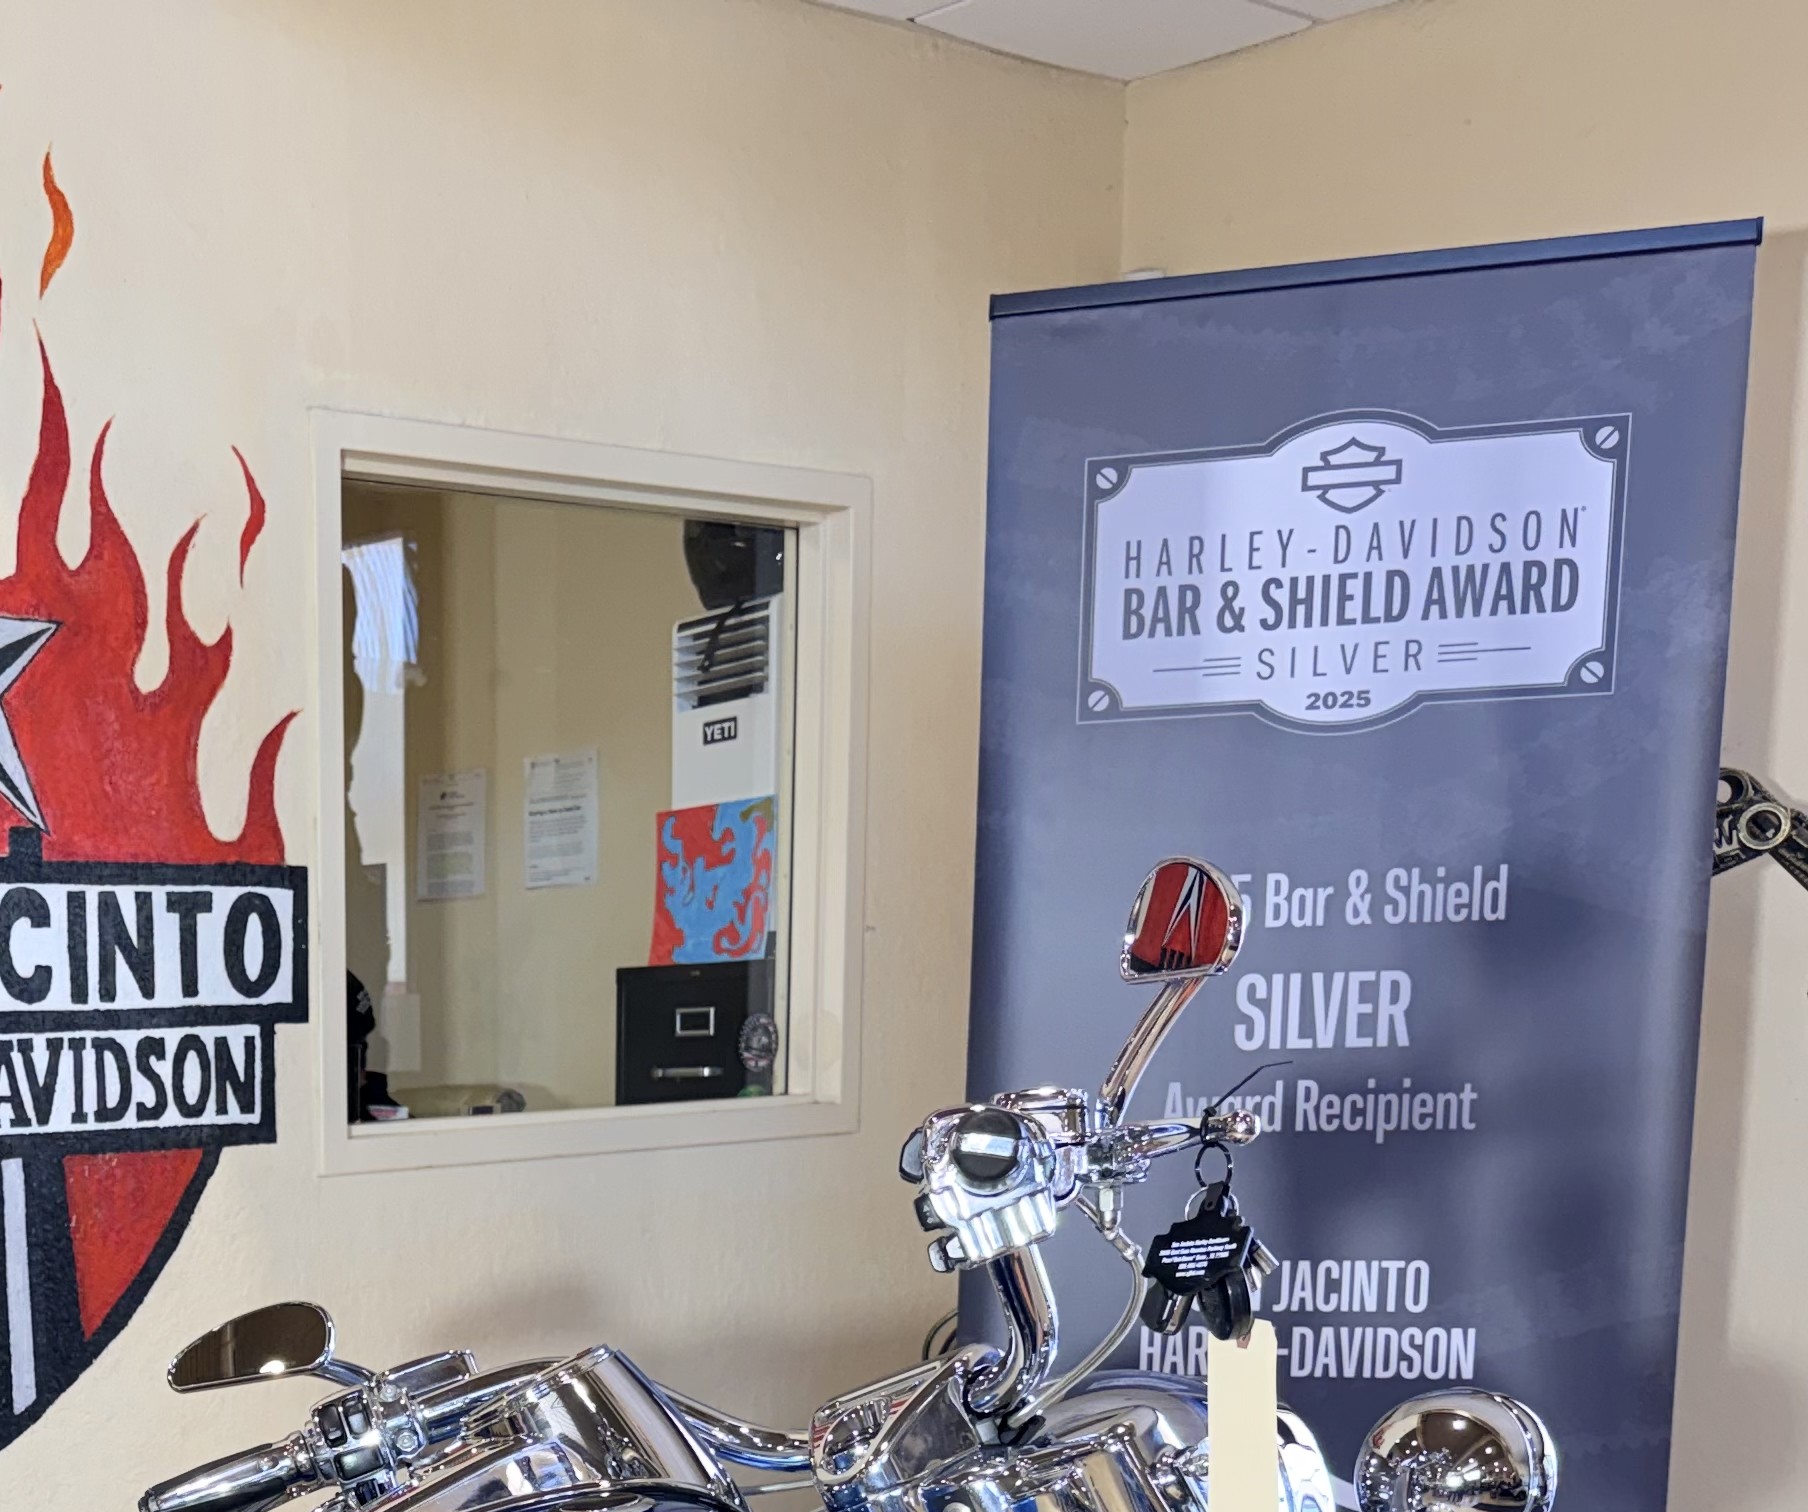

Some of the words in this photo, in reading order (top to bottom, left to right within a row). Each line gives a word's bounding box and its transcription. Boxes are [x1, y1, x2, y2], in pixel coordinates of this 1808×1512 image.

[1121, 583, 1201, 640] BAR
[1216, 580, 1245, 633] &
[1258, 568, 1410, 631] SHIELD
[1421, 557, 1580, 621] AWARD
[1256, 639, 1424, 680] SILVER
[1305, 690, 1371, 711] 2025
[704, 721, 735, 741] YETI
[1265, 872, 1335, 929] Bar
[1345, 868, 1372, 926] &
[1384, 863, 1509, 925] Shield
[1234, 969, 1412, 1051] SILVER
[1295, 1077, 1479, 1144] Recipient
[1272, 1259, 1430, 1314] JACINTO
[1139, 1325, 1476, 1380] HAR-DAVIDSON
